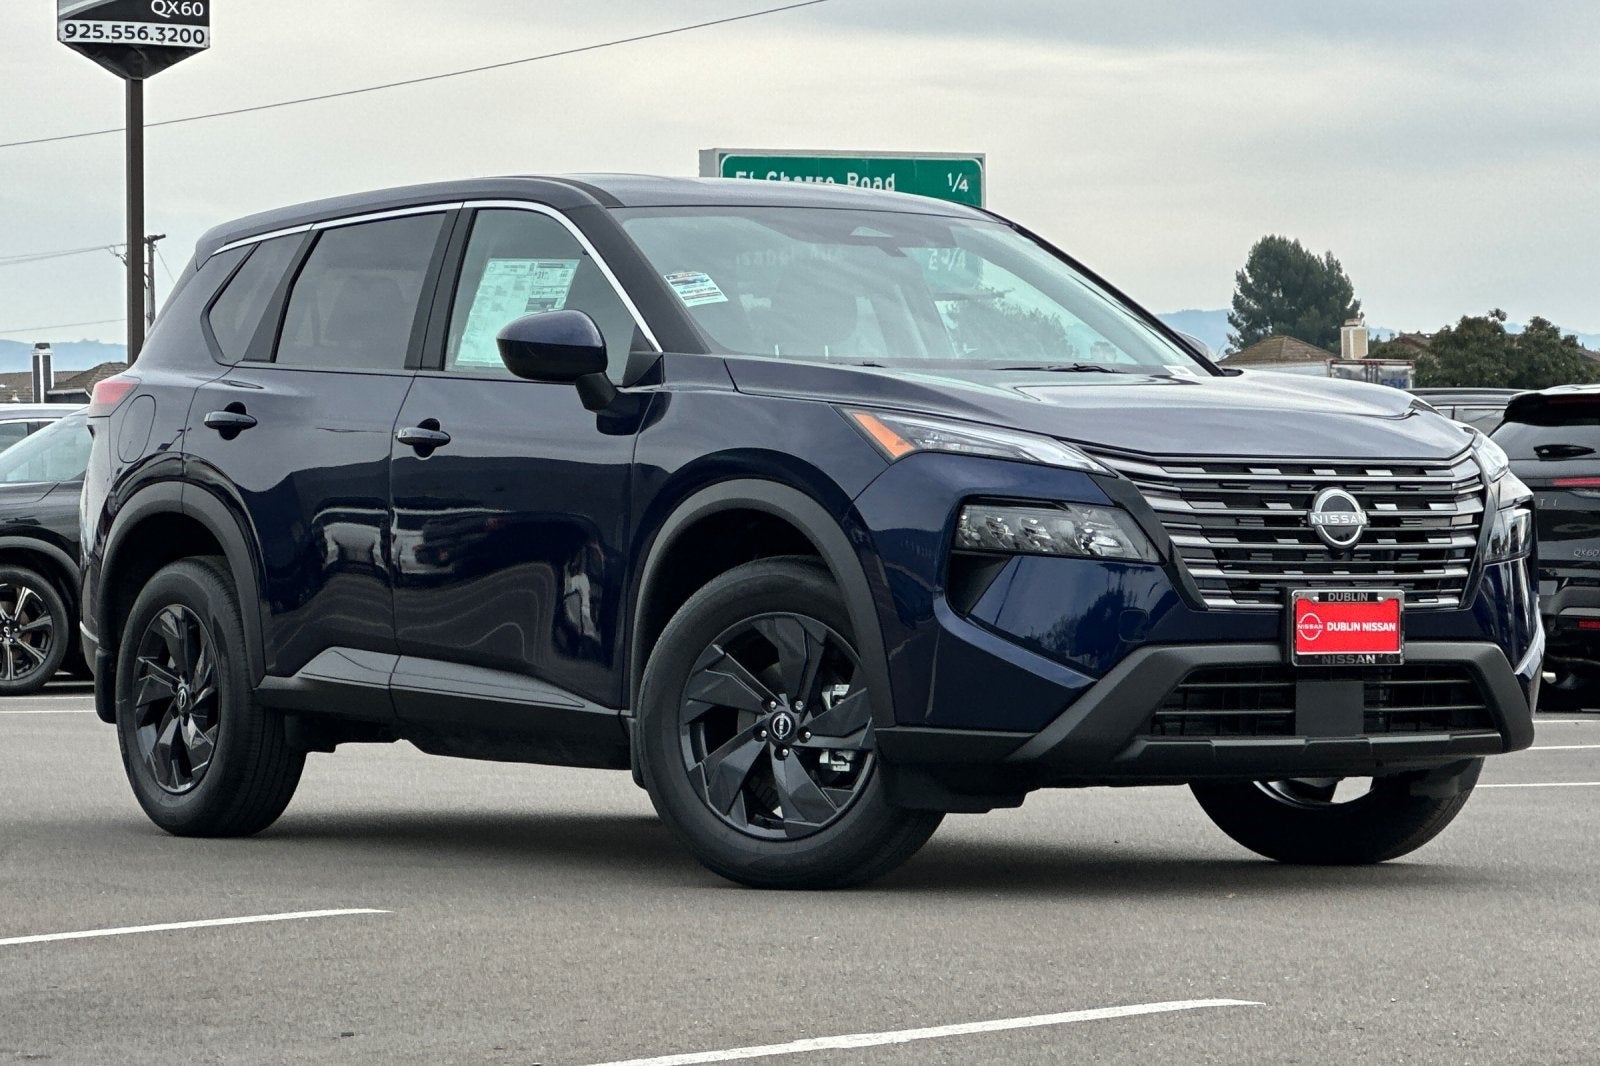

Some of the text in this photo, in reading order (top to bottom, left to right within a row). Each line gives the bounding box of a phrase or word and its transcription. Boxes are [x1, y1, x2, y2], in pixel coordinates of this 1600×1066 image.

[151, 0, 204, 18] QX60
[64, 23, 205, 44] 925.556.3200
[846, 172, 895, 192] Road
[1312, 514, 1367, 524] NISSAN
[1327, 592, 1368, 602] DUBLIN
[1327, 622, 1396, 631] DUBLIN NISSAN
[1321, 654, 1376, 664] NISSAN
